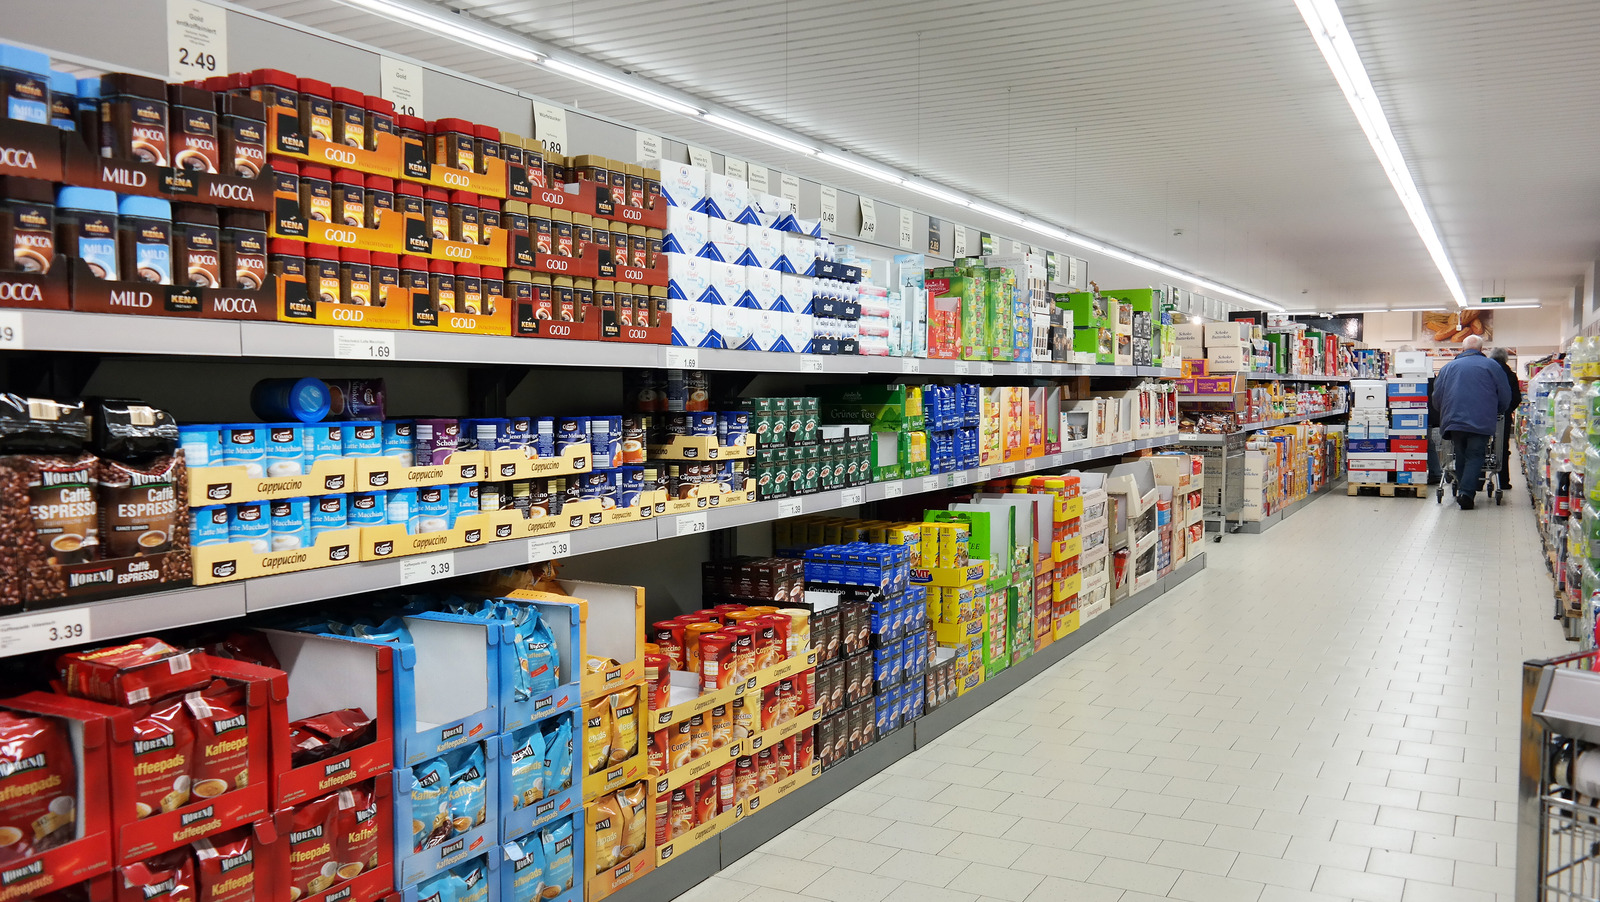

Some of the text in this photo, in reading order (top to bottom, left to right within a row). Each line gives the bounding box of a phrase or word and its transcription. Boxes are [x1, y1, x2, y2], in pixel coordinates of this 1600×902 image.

[179, 48, 216, 71] 2.49
[395, 72, 407, 80] Gold
[137, 108, 161, 120] KENA
[133, 127, 164, 142] MOCCA
[186, 137, 214, 151] MOCCA
[282, 136, 304, 148] KENA
[236, 145, 263, 160] MOCCA
[325, 148, 356, 164] GOLD
[408, 162, 427, 173] KENA
[102, 166, 147, 187] MILD
[165, 176, 193, 188] KENA
[444, 172, 470, 187] GOLD
[209, 182, 255, 202] MOCCA
[513, 184, 529, 193] KENA
[542, 192, 564, 205] GOLD
[599, 202, 612, 211] KENA
[20, 214, 47, 225] KENA
[623, 208, 641, 220] GOLD
[822, 211, 835, 223] 0.49
[281, 219, 304, 231] KENA
[863, 222, 874, 232] 0.49
[15, 234, 52, 248] MOCCA
[142, 230, 164, 239] KENA
[325, 228, 356, 244] GOLD
[84, 243, 113, 255] MILD
[241, 240, 260, 249] KENA
[409, 237, 429, 248] KENA
[140, 249, 167, 260] MILD
[445, 245, 472, 259] GOLD
[518, 252, 533, 261] KENA
[189, 254, 217, 266] MOCCA
[237, 258, 264, 269] MOCCA
[546, 259, 567, 271] GOLD
[624, 269, 643, 280] GOLD
[321, 279, 338, 288] GOLD
[353, 283, 369, 291] GOLD
[0, 283, 42, 301] OCCA
[109, 289, 153, 308] MILD
[171, 295, 198, 305] KENA
[214, 298, 257, 313] MOCCA
[289, 302, 312, 313] KENA
[332, 309, 364, 322] GOLD
[416, 312, 435, 321] KENA
[450, 317, 476, 329] GOLD
[521, 320, 536, 329] KENA
[549, 325, 570, 336] GOLD
[628, 329, 646, 338] GOLD
[368, 345, 390, 358] 1.69
[831, 409, 875, 419] Grüner Tee
[725, 448, 740, 456] Cappuccino
[531, 461, 560, 472] Cappuccino
[43, 469, 89, 486] MORENO
[407, 468, 444, 484] Cappuccino
[257, 479, 302, 494] Cappuccino
[60, 488, 91, 503] Caffè
[147, 488, 174, 502] Caffè
[852, 495, 860, 504] 1.39
[30, 500, 97, 521] ESPRESSO
[118, 499, 176, 518] ESPRESSO
[673, 502, 691, 511] Cappuccino
[791, 505, 800, 514] 1.39
[528, 520, 556, 532] Cappuccino
[693, 522, 704, 531] 2.79
[413, 535, 448, 548] Cappuccino
[552, 544, 567, 555] 3.39
[262, 552, 307, 569] Cappuccino
[128, 562, 150, 573] Caffè
[430, 562, 450, 575] 3.39
[910, 569, 930, 579] OVIT
[70, 569, 114, 587] MORENO
[117, 570, 159, 584] ESPRESSO
[49, 623, 83, 641] 3.39
[606, 671, 621, 681] MORENO
[774, 665, 792, 677] Cappuccino
[602, 679, 625, 691] Kaffeepads
[535, 697, 552, 709] MORENO
[694, 696, 717, 711] Cappuccino
[531, 704, 556, 721] Kaffeepads
[215, 715, 246, 734] MORENO
[780, 722, 798, 736] Cappuccino
[443, 725, 463, 739] MORENO
[134, 734, 174, 753] MORENO
[205, 736, 248, 757] Kaffeepa
[436, 736, 468, 753] Kaffeepads
[134, 754, 184, 776] ffeepads
[325, 758, 351, 775] MORENO
[689, 759, 710, 776] Cappuccino
[318, 769, 357, 790] Kaffeepads
[608, 770, 622, 780] MORENO
[0, 774, 61, 799] affeepads
[604, 777, 626, 791] Kaffeepads
[778, 779, 796, 794] Cappuccino
[537, 802, 554, 814] MORENO
[182, 806, 214, 824] MORENO
[532, 809, 558, 827] Kaffeepads
[173, 818, 221, 842] Kaffeepads
[290, 824, 322, 843] MORENO
[694, 822, 717, 840] Cappuccino
[442, 840, 463, 857] MORENO
[436, 850, 468, 870] Kaffeepads
[2, 861, 43, 884] MORENO
[616, 864, 630, 878] MORENO
[212, 872, 254, 896] Kaffeepa
